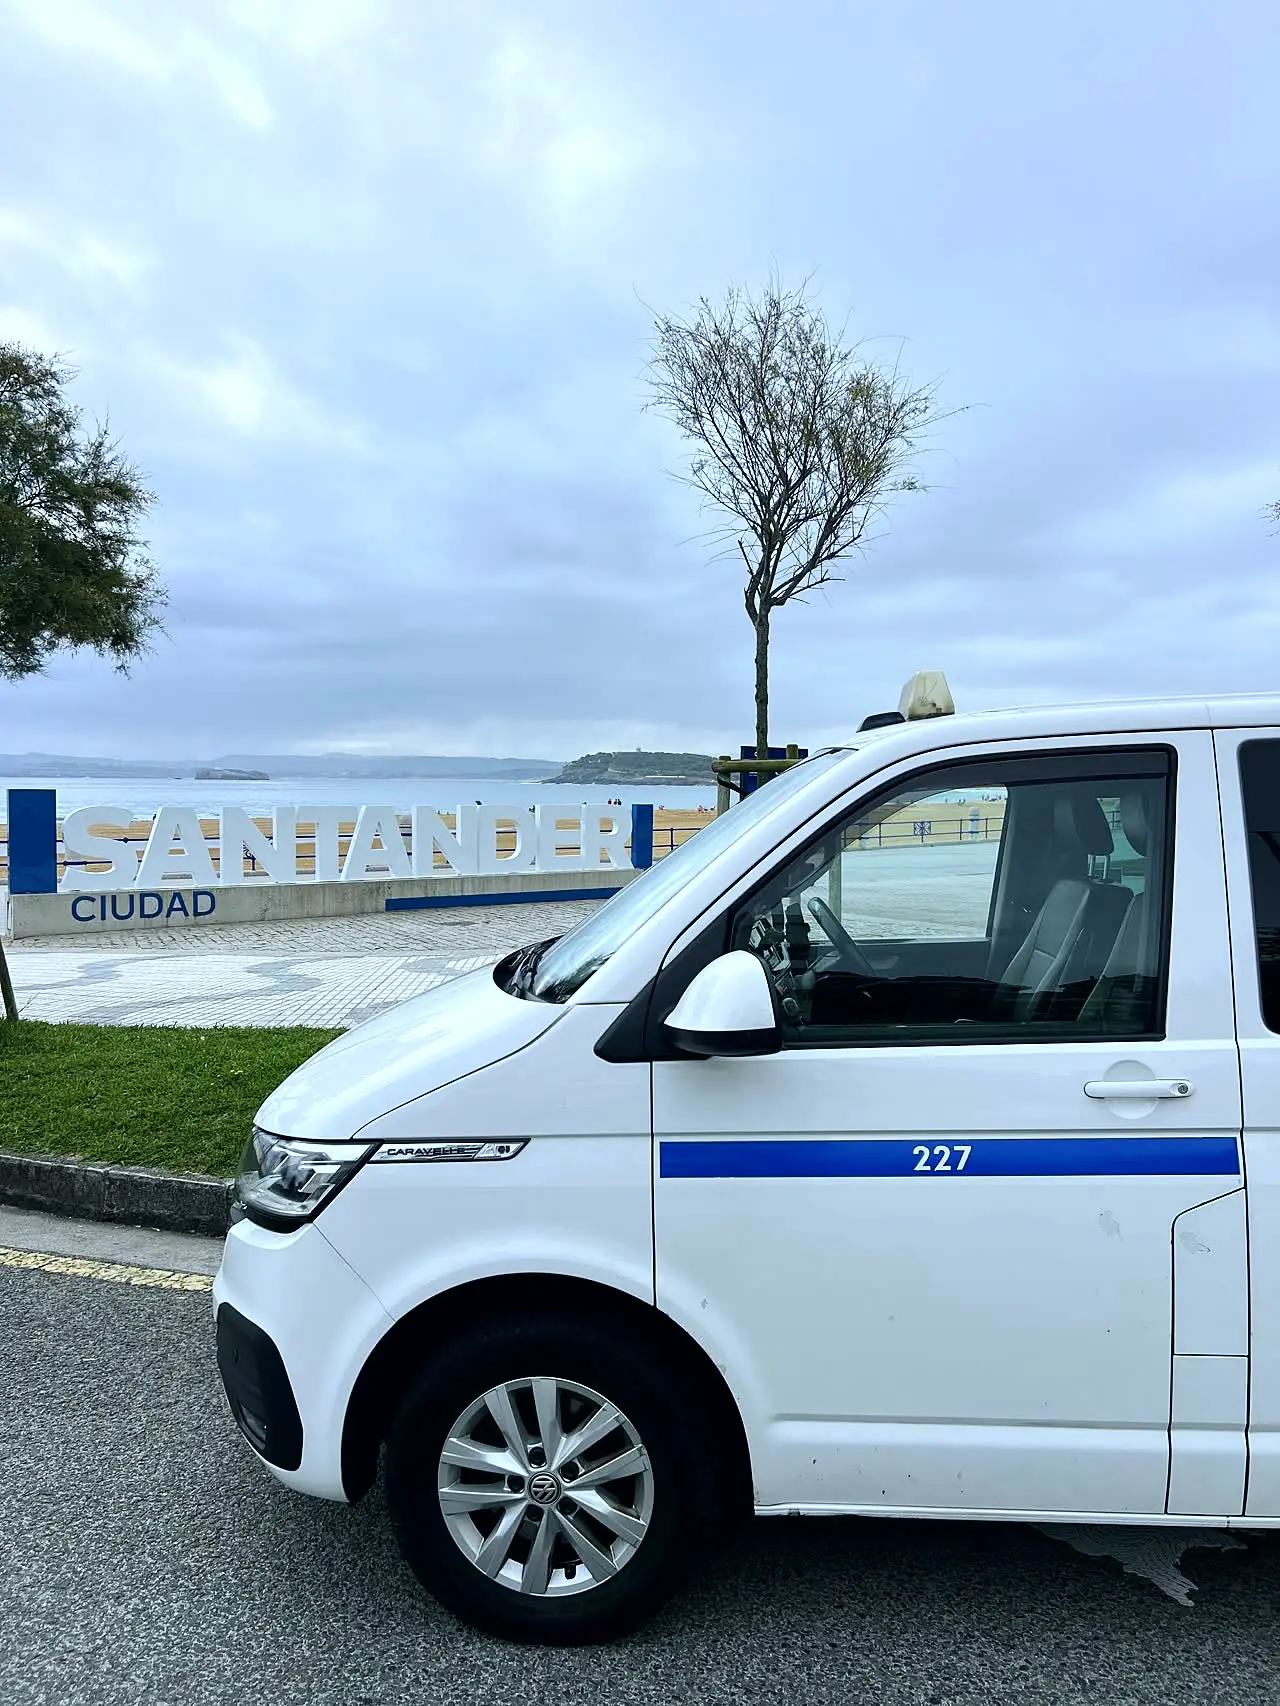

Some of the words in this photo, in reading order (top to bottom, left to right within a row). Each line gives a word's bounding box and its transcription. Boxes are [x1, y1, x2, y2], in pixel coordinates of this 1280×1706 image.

[60, 803, 633, 889] SANTANDER
[71, 891, 216, 922] CIUDAD
[387, 1148, 466, 1156] CARAVELLE
[912, 1145, 972, 1171] 227
